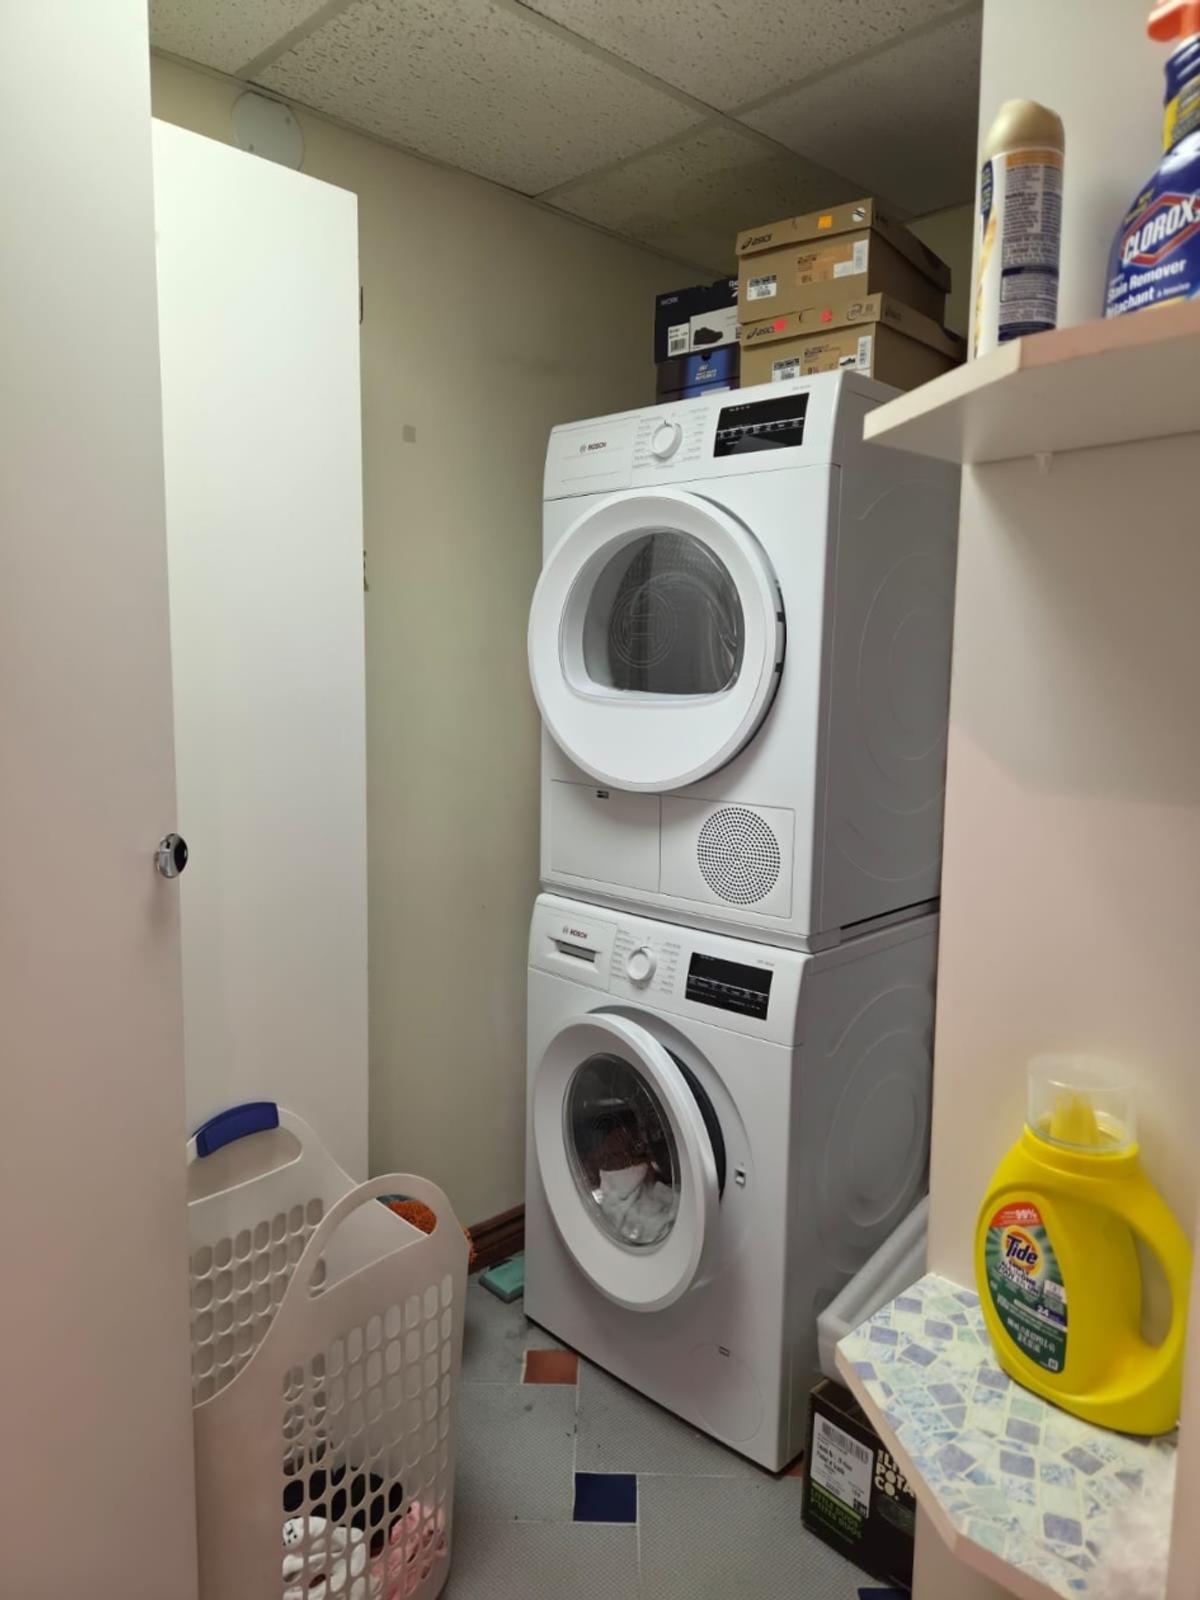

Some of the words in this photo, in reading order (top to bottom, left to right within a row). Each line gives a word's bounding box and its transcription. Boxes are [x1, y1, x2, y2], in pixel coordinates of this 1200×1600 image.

[1129, 259, 1187, 290] Remover
[588, 442, 607, 451] BOSCH
[570, 929, 588, 940] BOSCH
[1006, 1234, 1039, 1265] Tide
